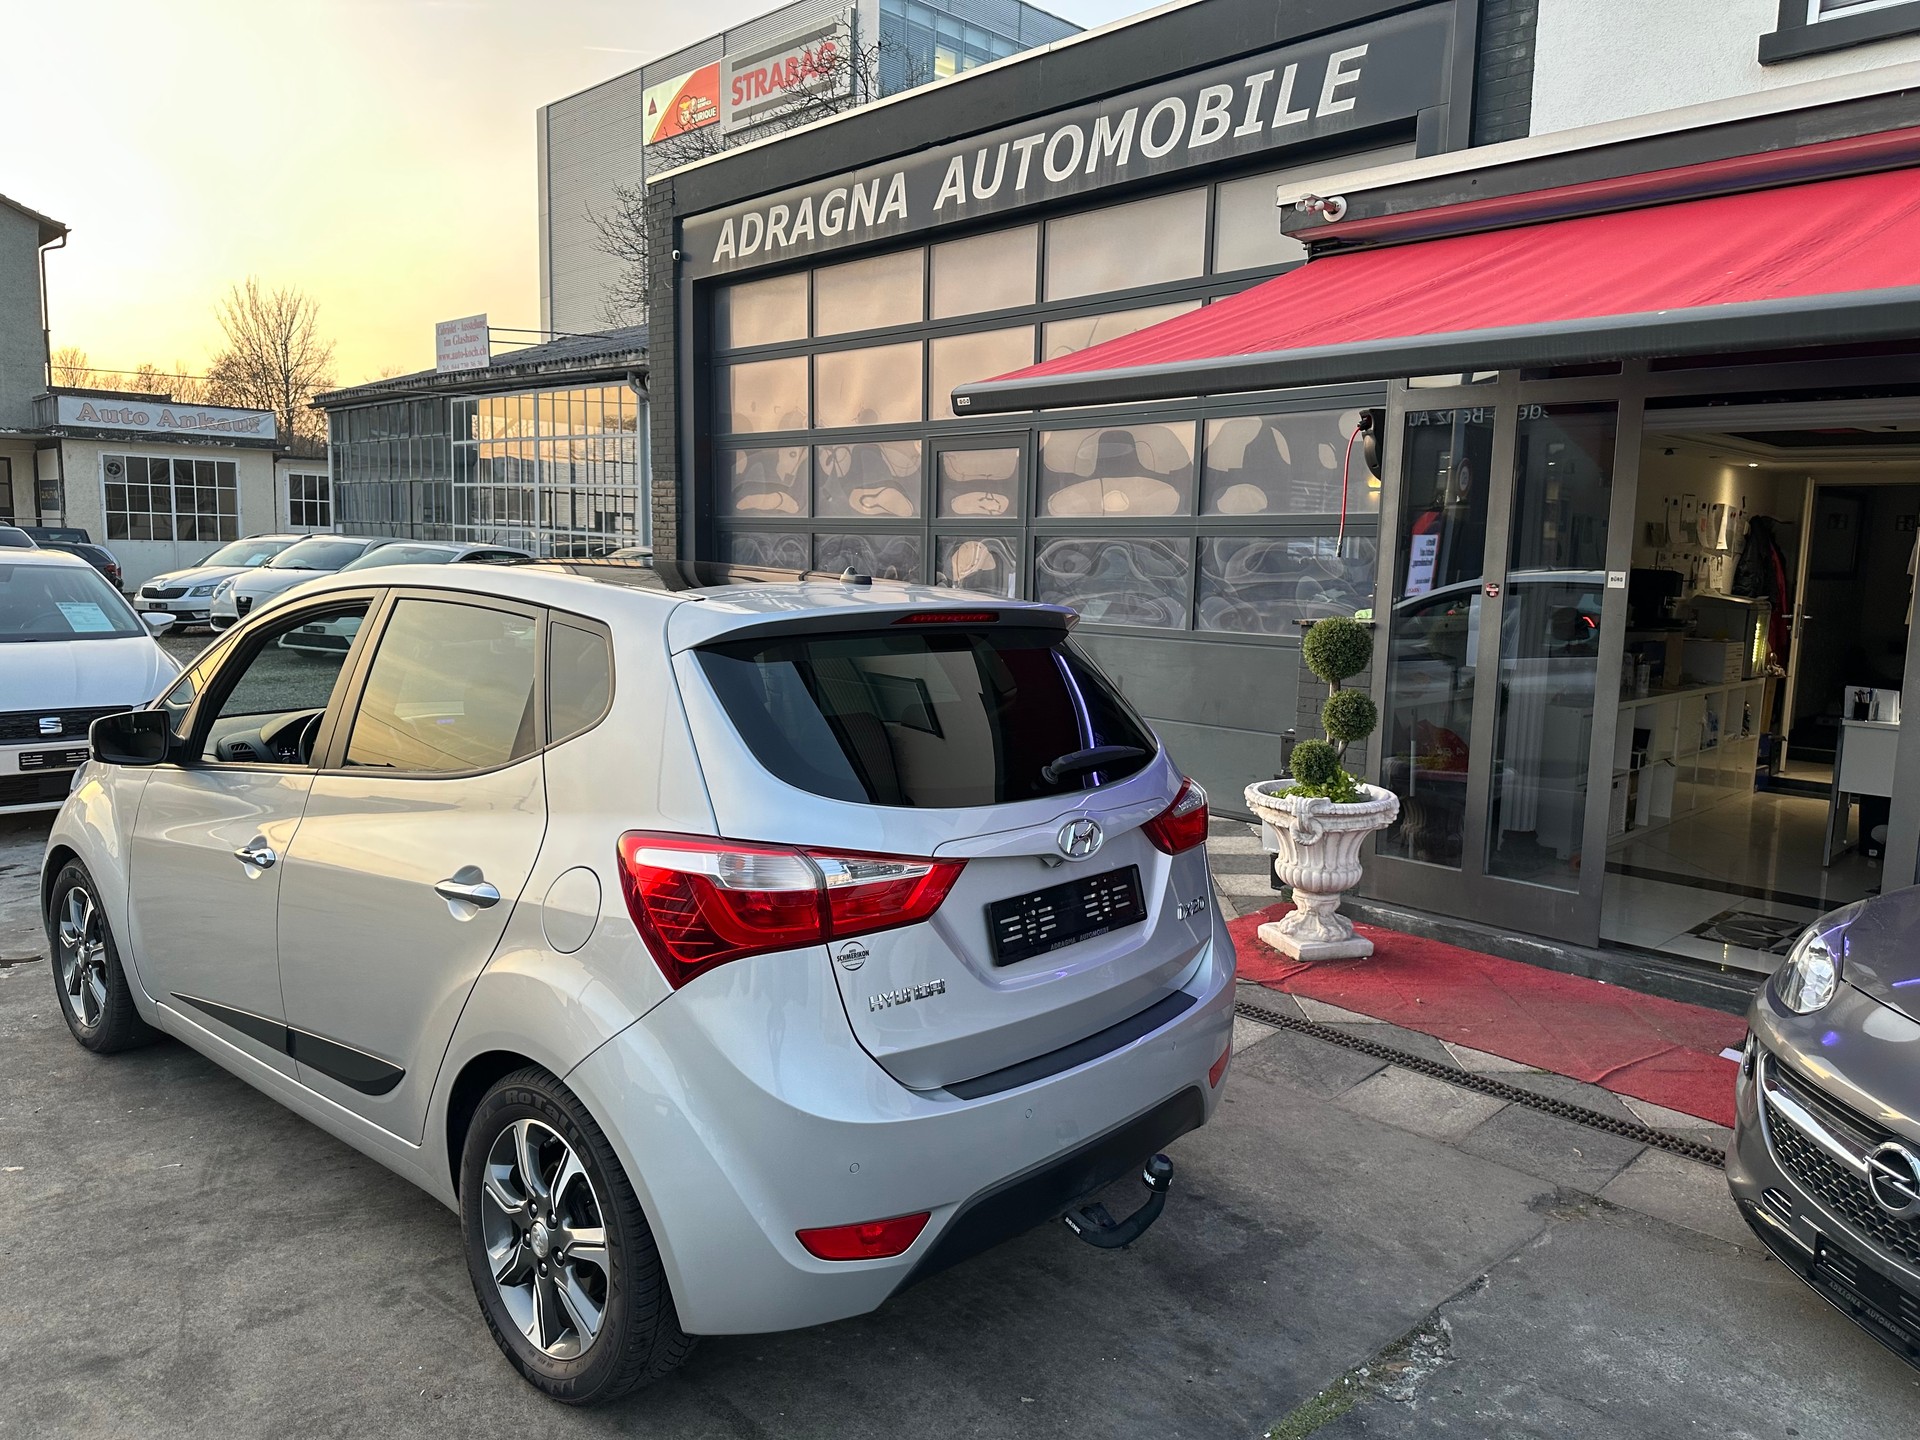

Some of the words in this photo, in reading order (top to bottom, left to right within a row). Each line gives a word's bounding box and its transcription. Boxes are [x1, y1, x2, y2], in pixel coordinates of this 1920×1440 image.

[731, 42, 836, 106] STRABAG
[712, 172, 909, 263] ADRAGNA
[934, 43, 1369, 210] AUTOMOBILE
[76, 402, 149, 426] Auto
[157, 408, 260, 433] Ankauf
[836, 949, 870, 962] SCHMERIKON
[869, 978, 946, 1012] HYUNDAI
